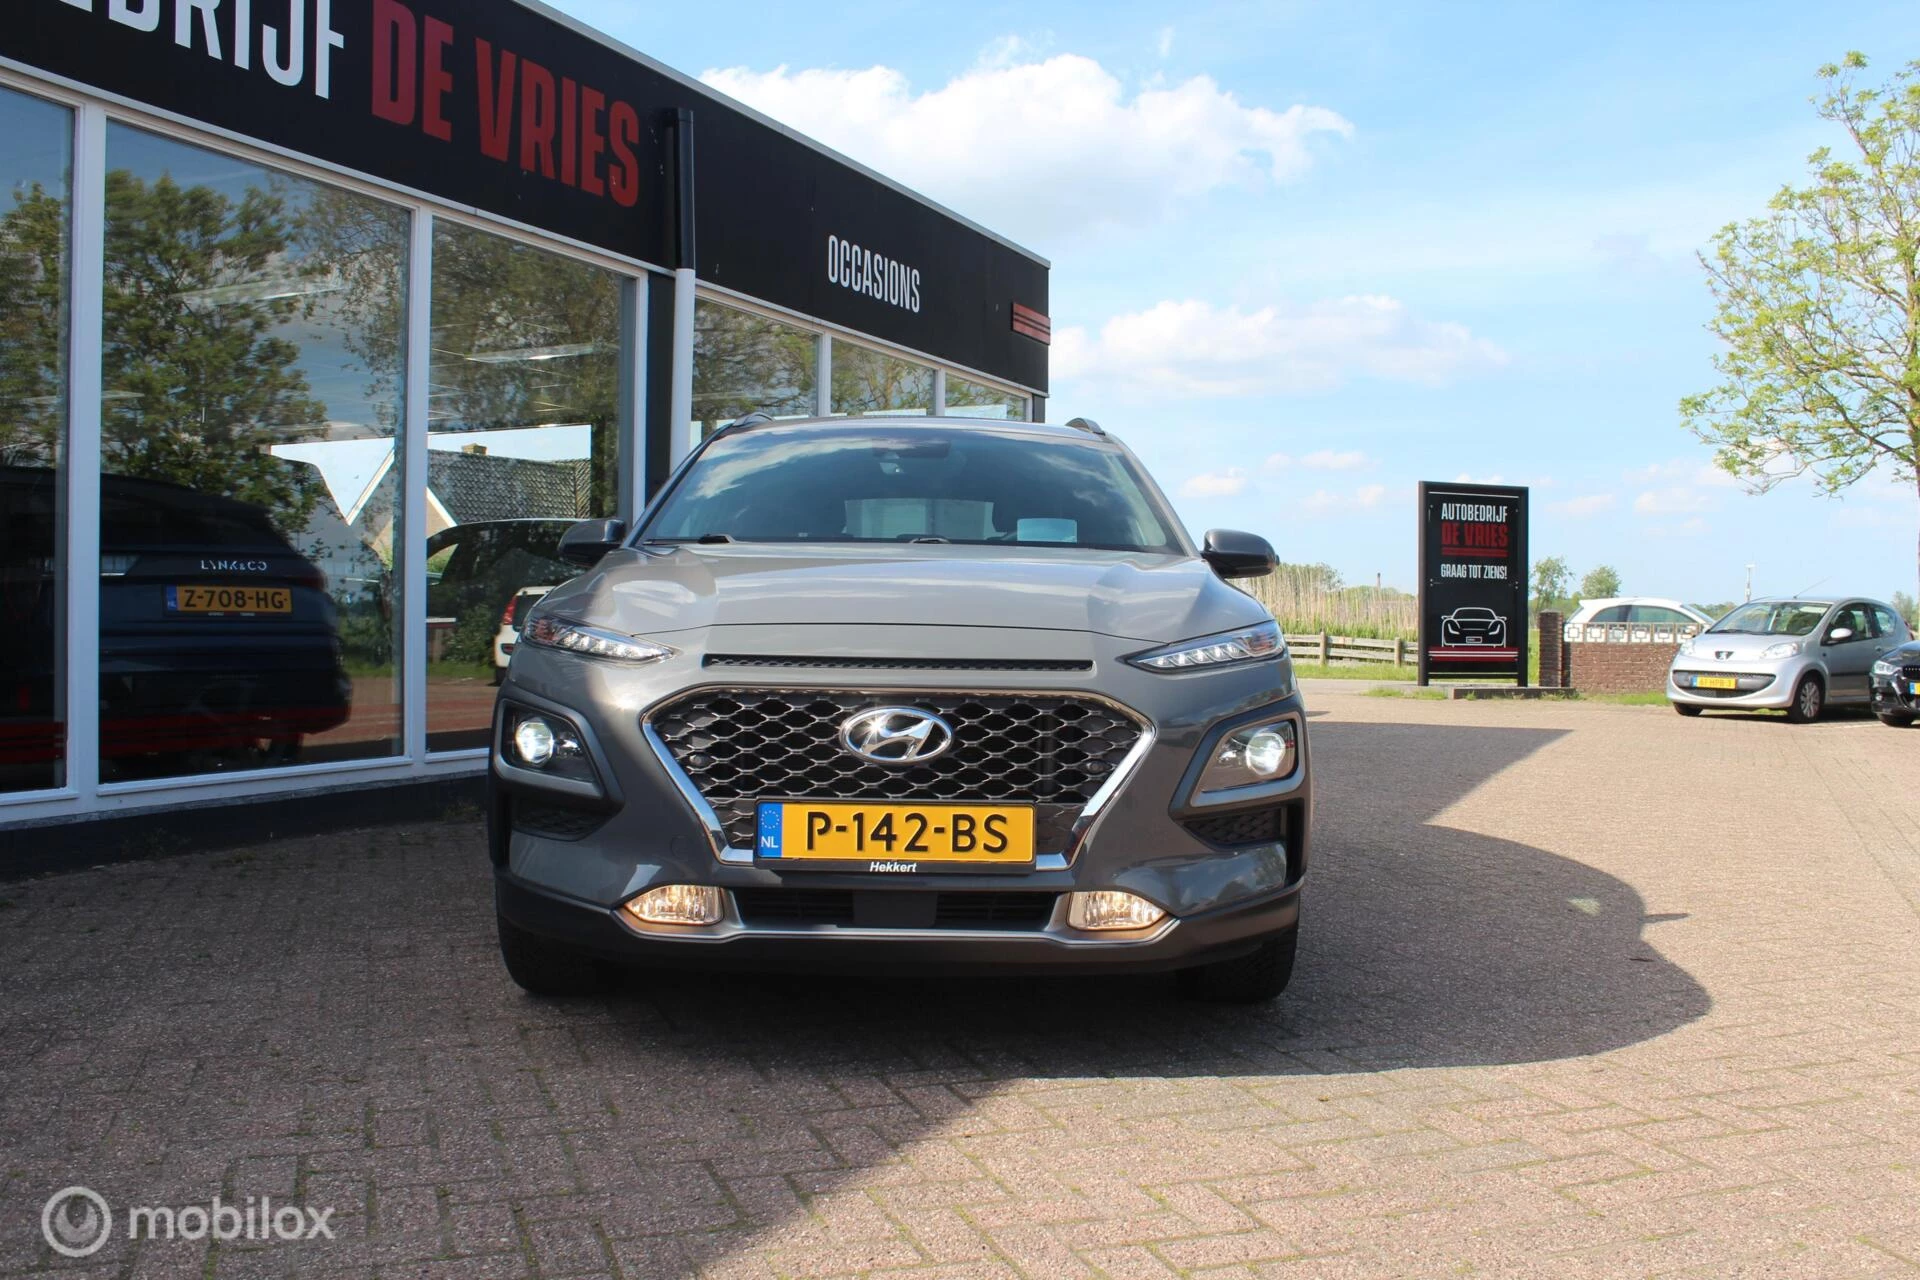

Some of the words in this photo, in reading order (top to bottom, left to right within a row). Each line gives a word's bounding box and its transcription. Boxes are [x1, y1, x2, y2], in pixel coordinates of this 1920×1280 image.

[371, 0, 454, 142] DE
[475, 37, 640, 207] VRIES
[827, 234, 921, 314] OCCASIONS
[1441, 503, 1508, 523] AUTOBEDRIJF
[1441, 521, 1460, 545] DE
[1463, 522, 1509, 547] VRIES
[1440, 563, 1467, 578] GRAAG
[1468, 564, 1481, 579] TOT
[1483, 565, 1508, 580] ZIENS!
[183, 588, 285, 609] Z-708-HG
[760, 835, 779, 849] NL
[806, 811, 1008, 853] P-142-BS
[869, 861, 917, 873] Hekkert
